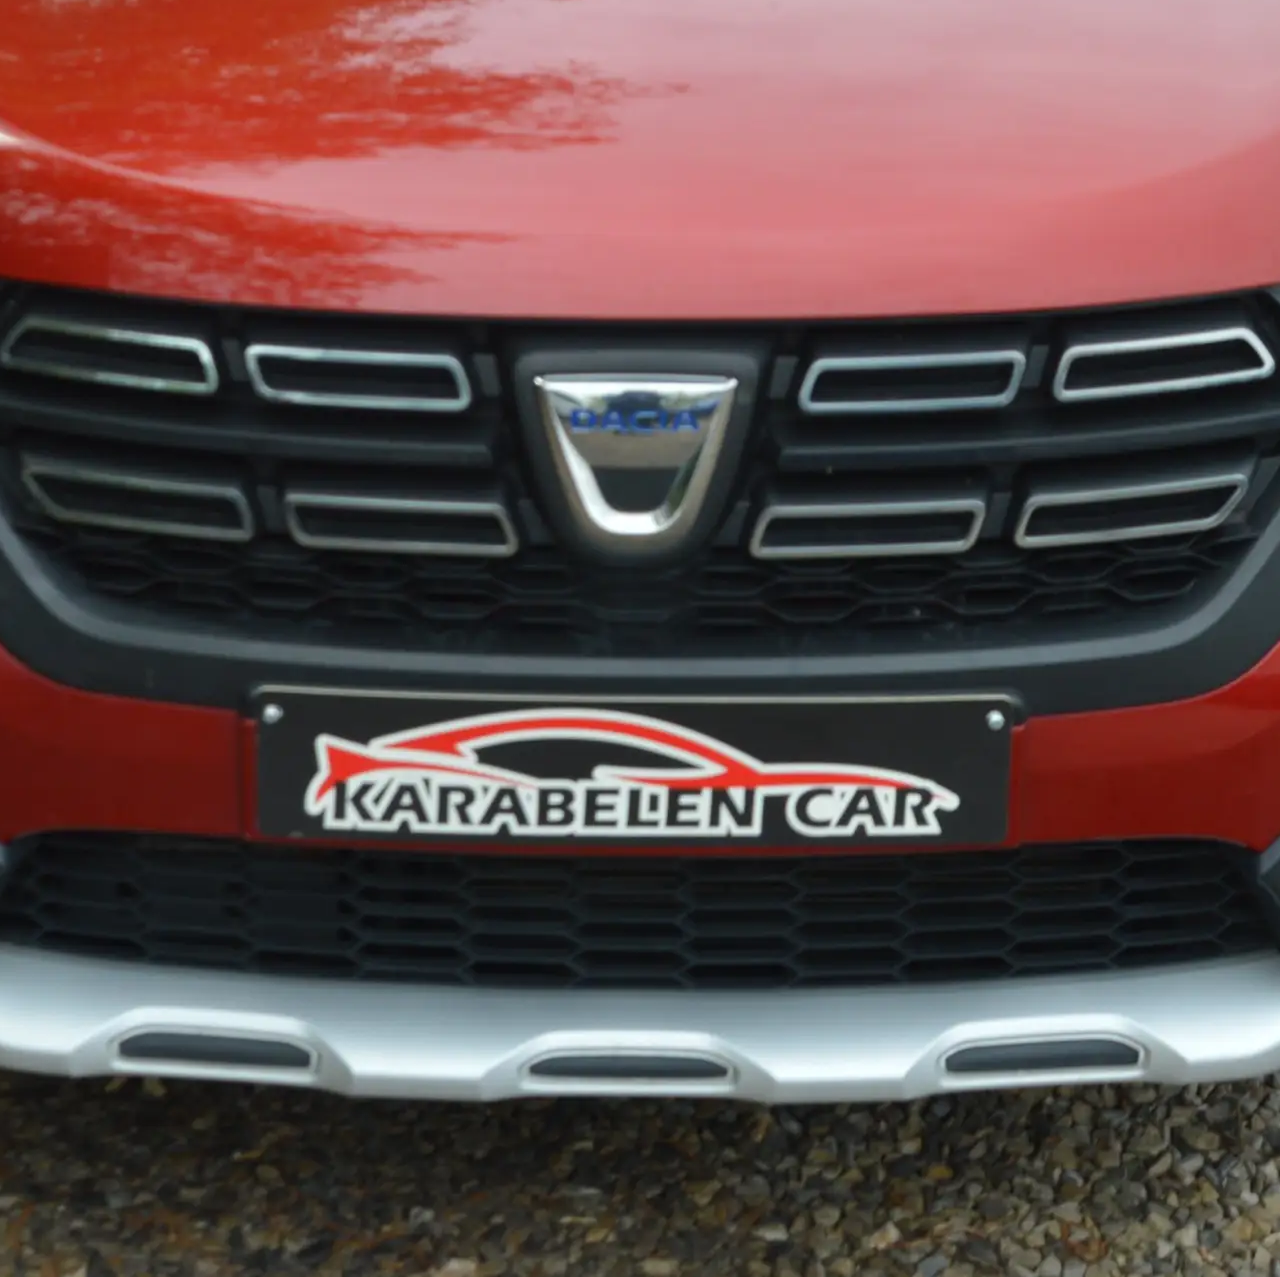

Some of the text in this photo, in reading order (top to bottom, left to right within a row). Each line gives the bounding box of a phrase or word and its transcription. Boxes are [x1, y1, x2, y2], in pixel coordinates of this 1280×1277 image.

[571, 408, 700, 434] DACIA
[333, 780, 938, 828] KARABELEN CAR
